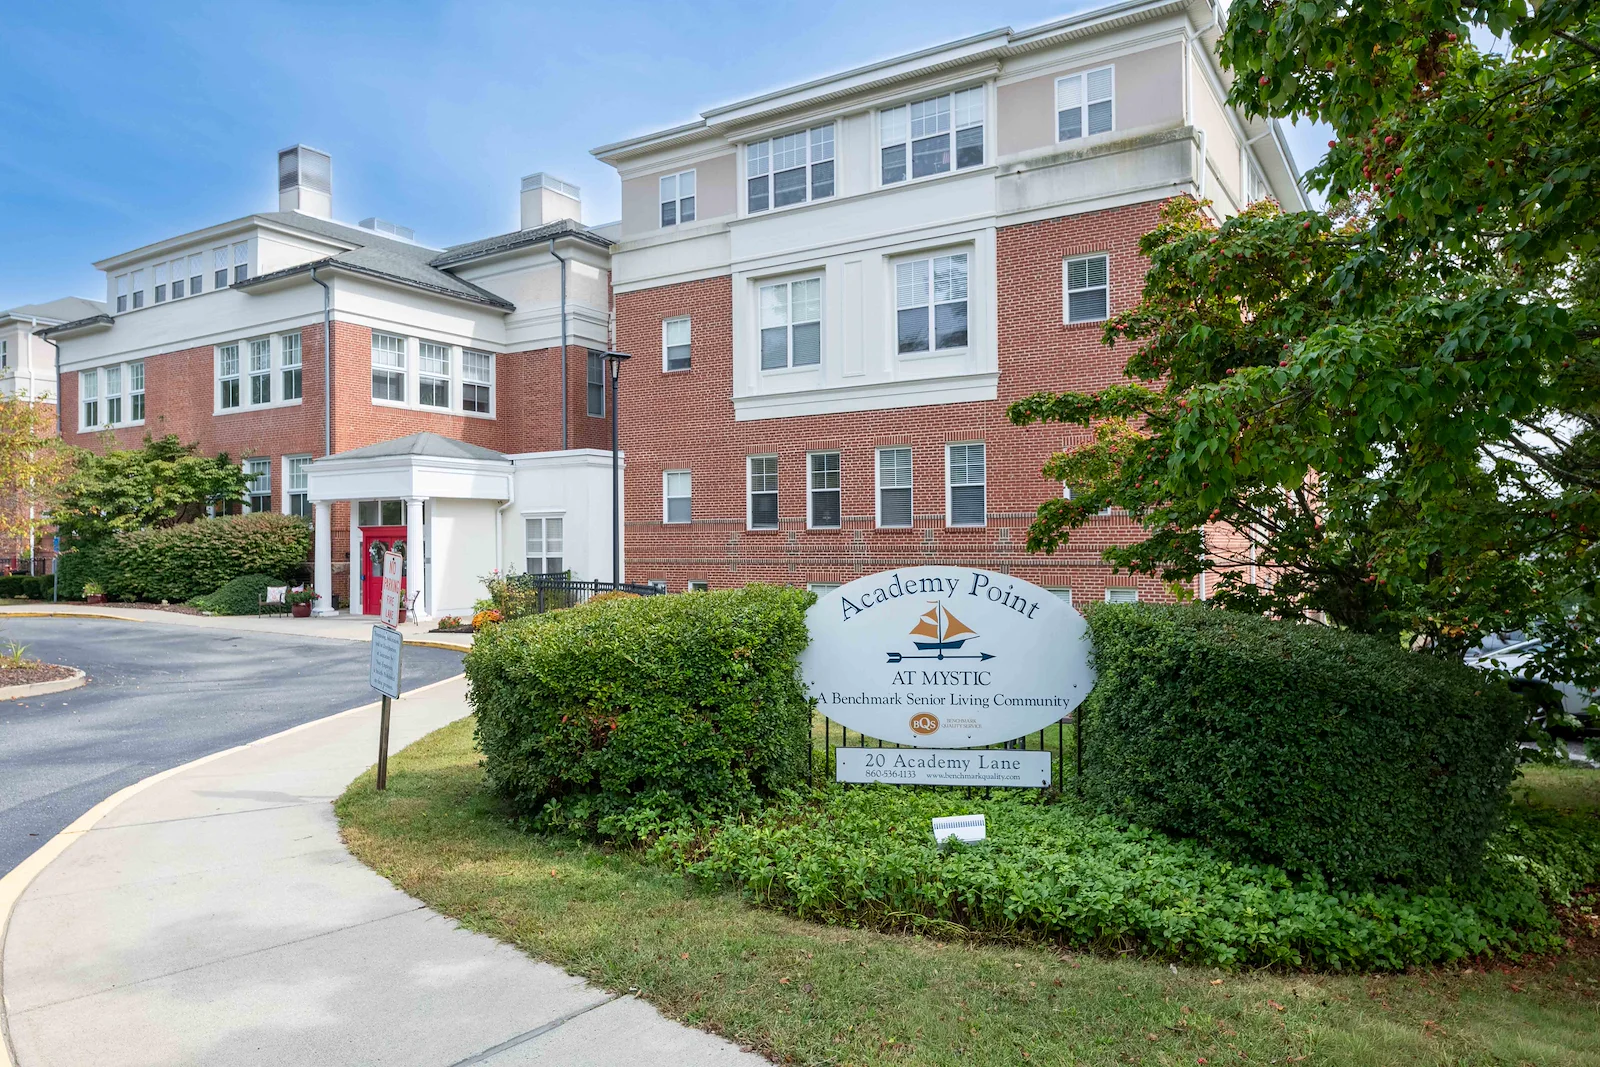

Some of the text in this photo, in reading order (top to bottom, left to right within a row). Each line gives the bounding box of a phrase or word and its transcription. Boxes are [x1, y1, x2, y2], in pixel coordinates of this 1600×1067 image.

[389, 561, 397, 575] NO
[384, 576, 400, 594] PARKING
[386, 594, 395, 607] FIRE
[841, 572, 1040, 622] Academy Point
[385, 609, 394, 620] LANE
[892, 670, 992, 686] AT MYSTIC
[818, 692, 1070, 710] A Benchmark Senior Living Community
[913, 717, 937, 730] BQS
[865, 753, 1021, 772] 20 Academy Lane
[865, 769, 1021, 782] 860-536-1133 www.benchmarkquality.com
